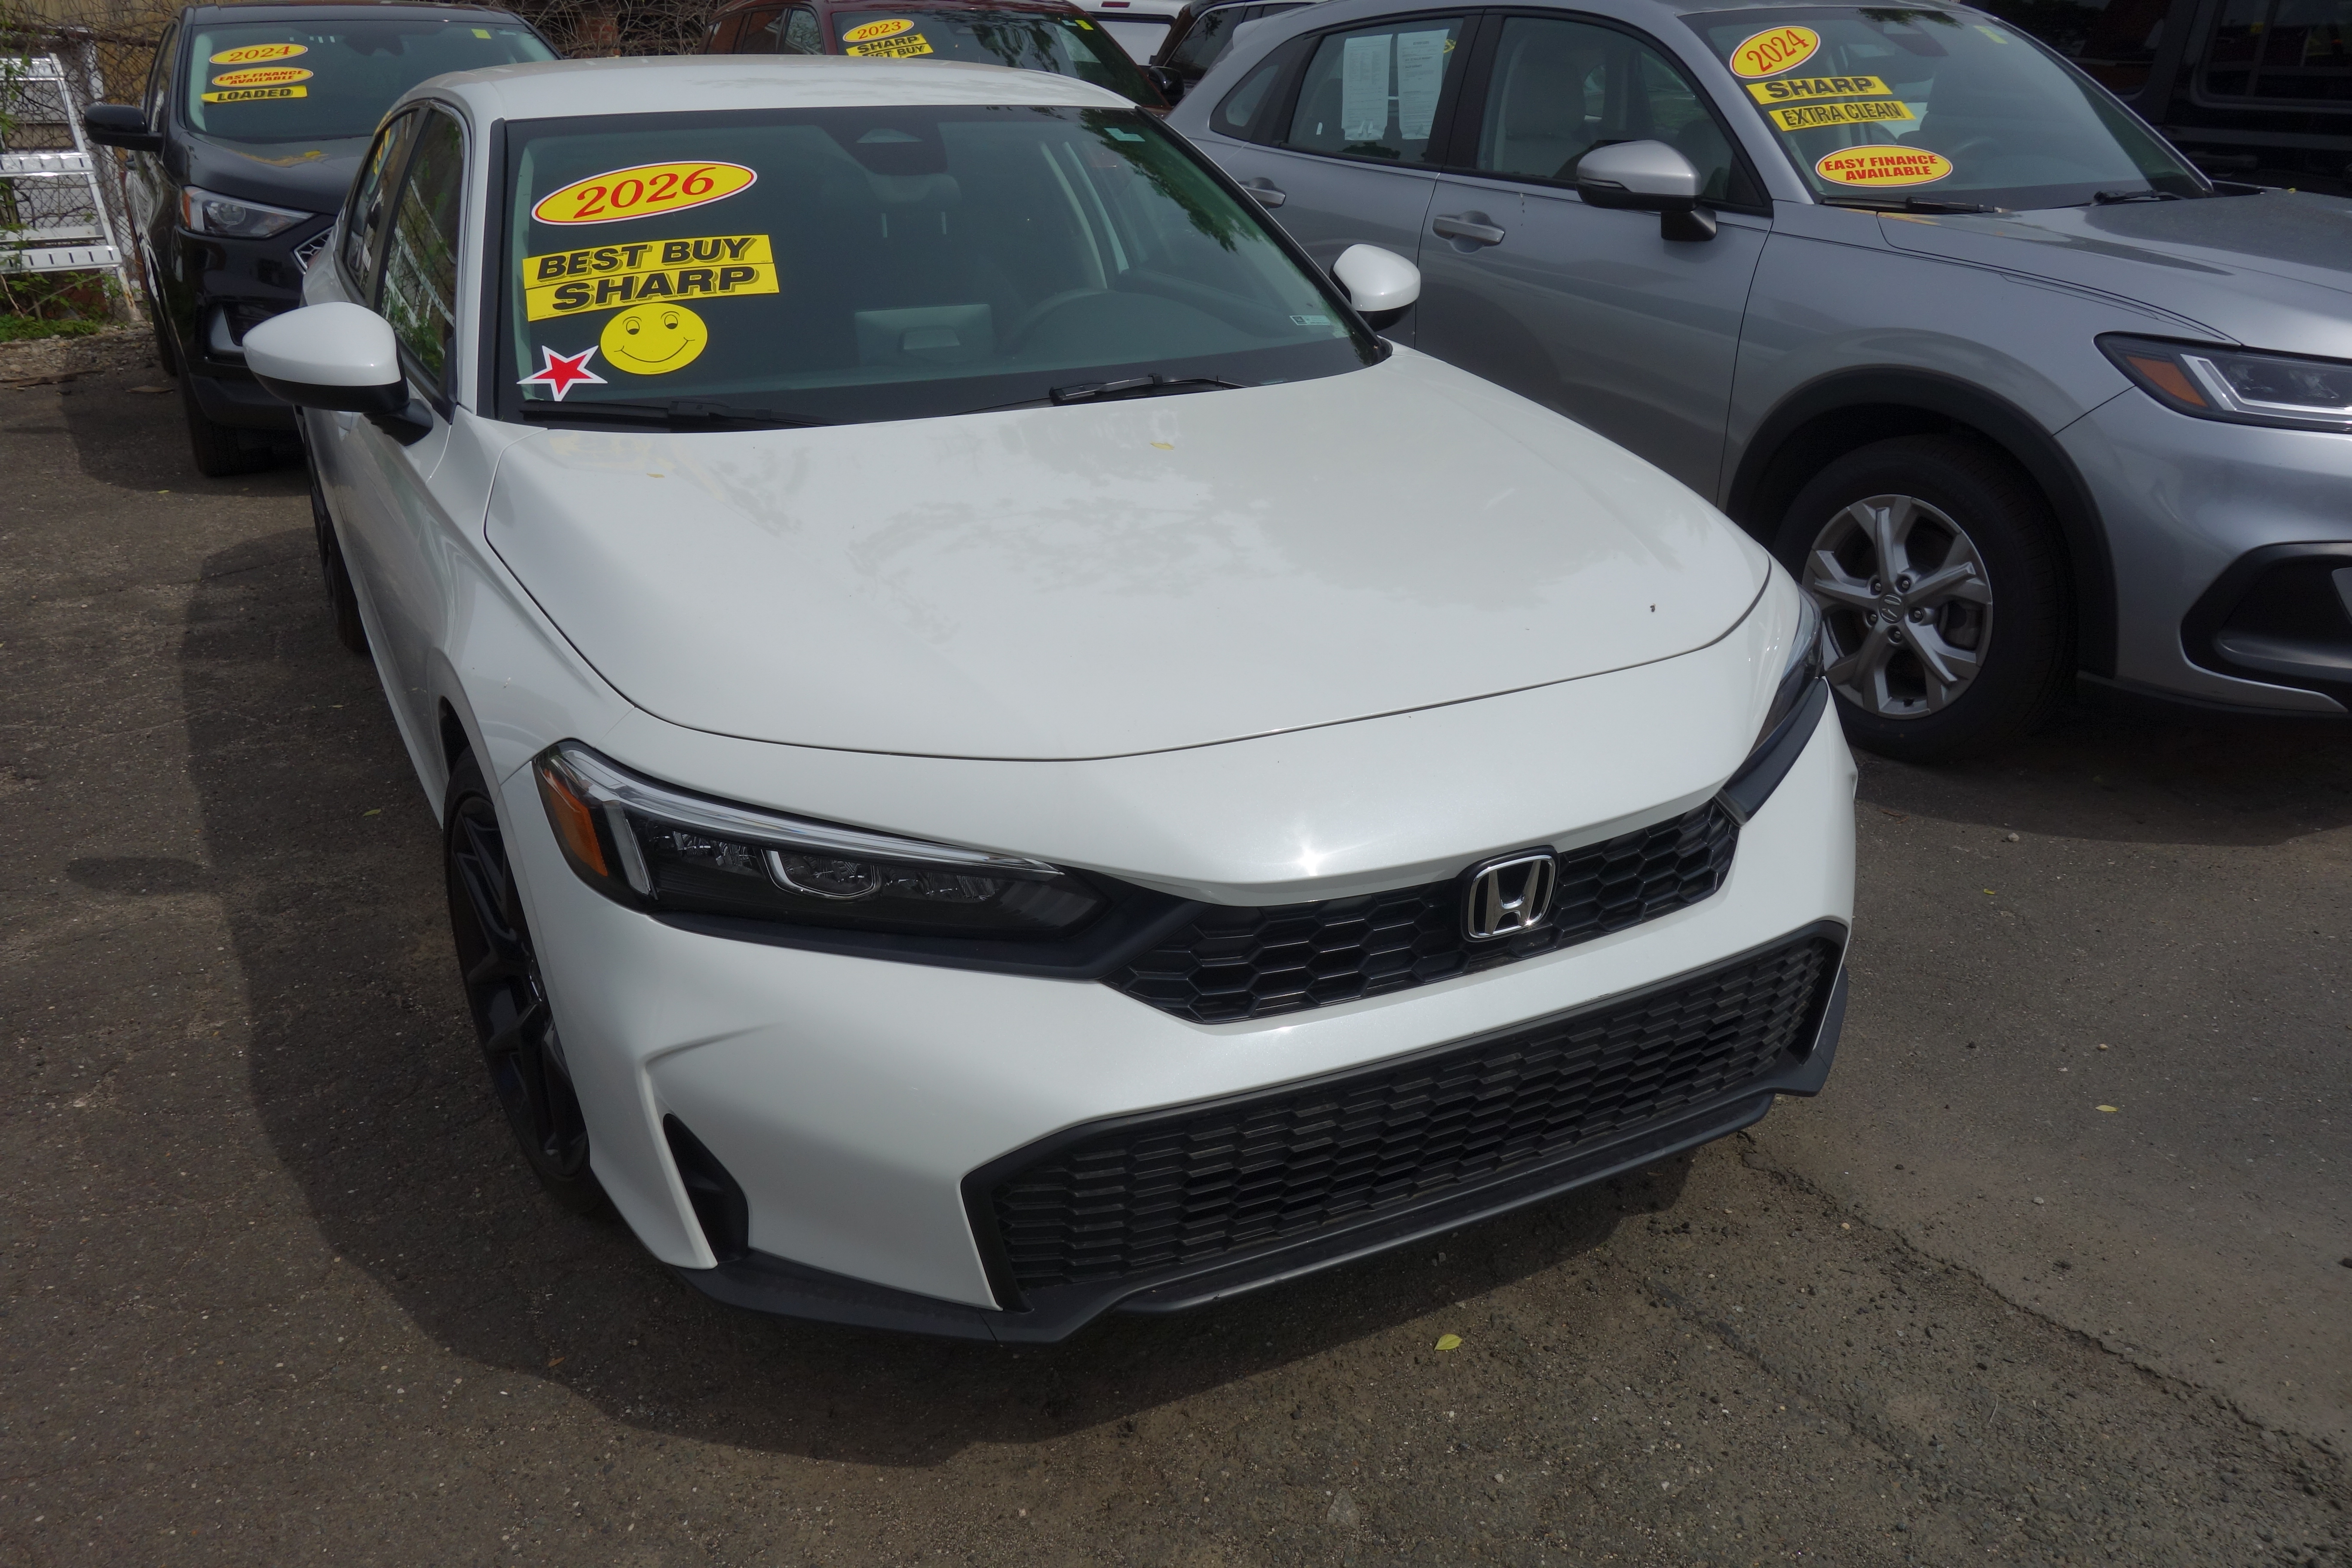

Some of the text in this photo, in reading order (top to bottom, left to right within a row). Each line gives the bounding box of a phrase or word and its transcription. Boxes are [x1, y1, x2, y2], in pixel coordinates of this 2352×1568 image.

[858, 21, 901, 40] 2023
[857, 36, 919, 53] SHARP
[897, 45, 925, 55] BUY
[1746, 30, 1809, 72] 2024
[228, 46, 291, 62] 2024
[230, 75, 294, 85] AVAILABLE
[1765, 77, 1876, 99] SHARP
[217, 89, 293, 101] LOADED
[1781, 102, 1905, 127] EXTRA CLEAN
[1824, 155, 1938, 171] EASY FINANCE
[1846, 166, 1932, 181] AVAILABLE
[573, 167, 716, 219] 2026
[537, 237, 757, 282] BEST BUY
[552, 266, 760, 312] SHARP
